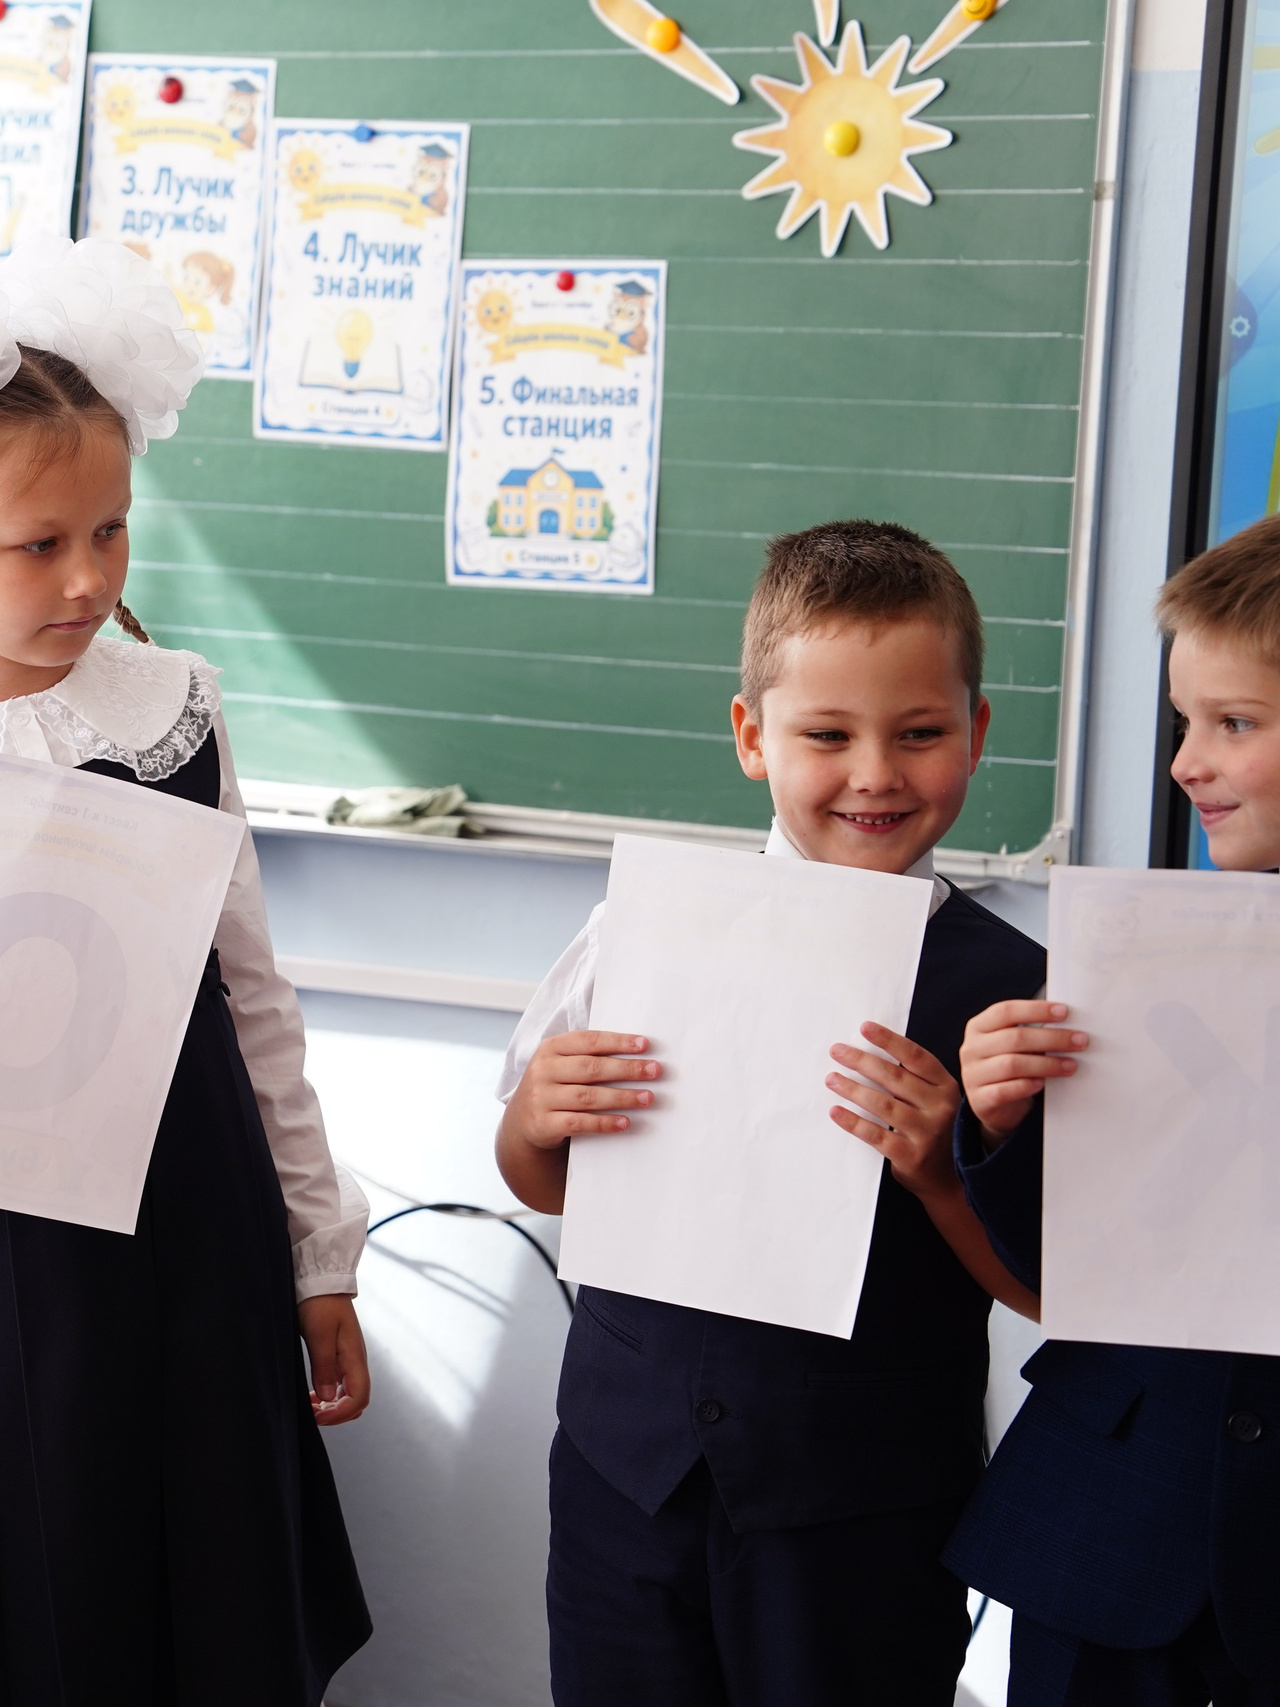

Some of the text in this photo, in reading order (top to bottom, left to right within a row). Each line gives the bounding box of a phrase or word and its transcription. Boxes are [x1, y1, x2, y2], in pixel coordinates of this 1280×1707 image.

[121, 165, 235, 204] 3. Лучик
[121, 205, 227, 238] дружбы
[303, 231, 423, 272] 4. Лучик
[312, 271, 415, 300] знаний
[479, 376, 640, 407] 5. Финальная
[502, 414, 613, 441] станция
